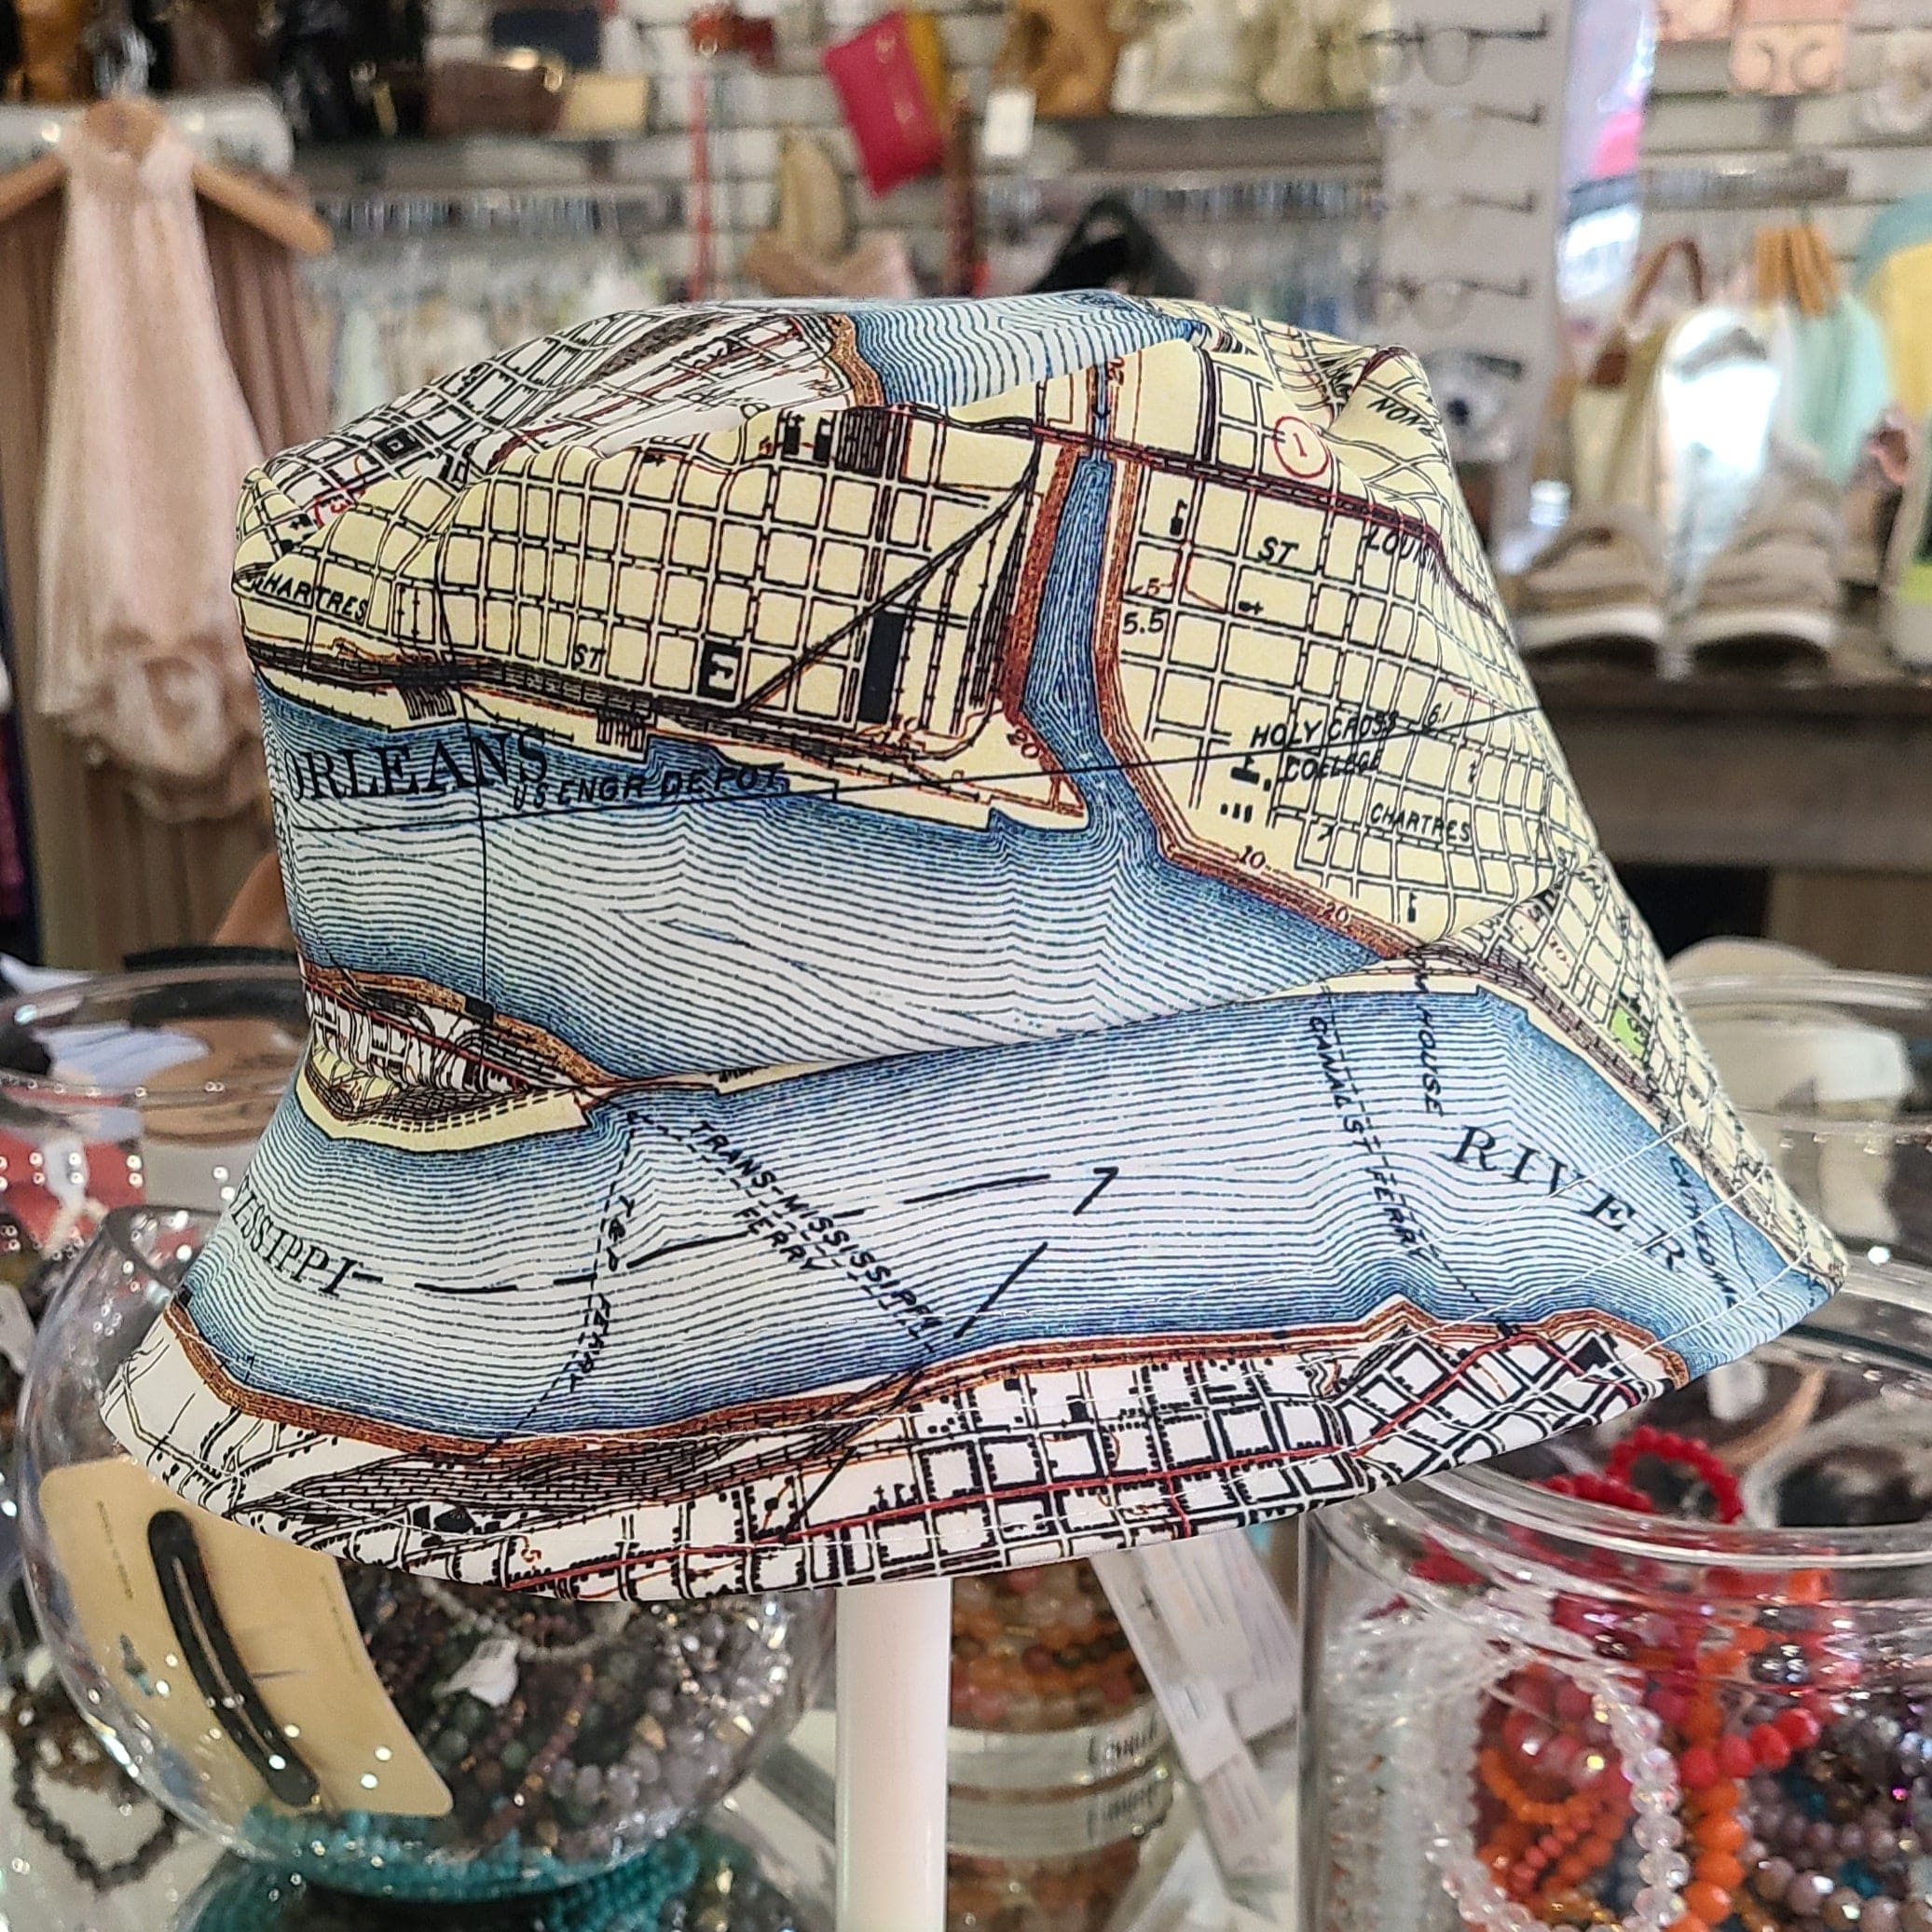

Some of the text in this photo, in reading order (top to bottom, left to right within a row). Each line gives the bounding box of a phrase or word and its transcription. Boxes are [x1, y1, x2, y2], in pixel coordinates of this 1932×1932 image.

[1259, 536, 1299, 565] ST
[1122, 610, 1164, 636] 5.5
[570, 643, 607, 671] ST
[1250, 710, 1400, 748] HOLY CROSS
[1369, 802, 1472, 843] CHARTRES
[1238, 844, 1267, 870] 10
[1415, 1003, 1446, 1117] HOUSE
[1308, 1016, 1353, 1109] CANAL
[1363, 1167, 1434, 1261] FERRY
[1449, 1123, 1687, 1273] RIVER
[732, 1209, 829, 1273] FERRY
